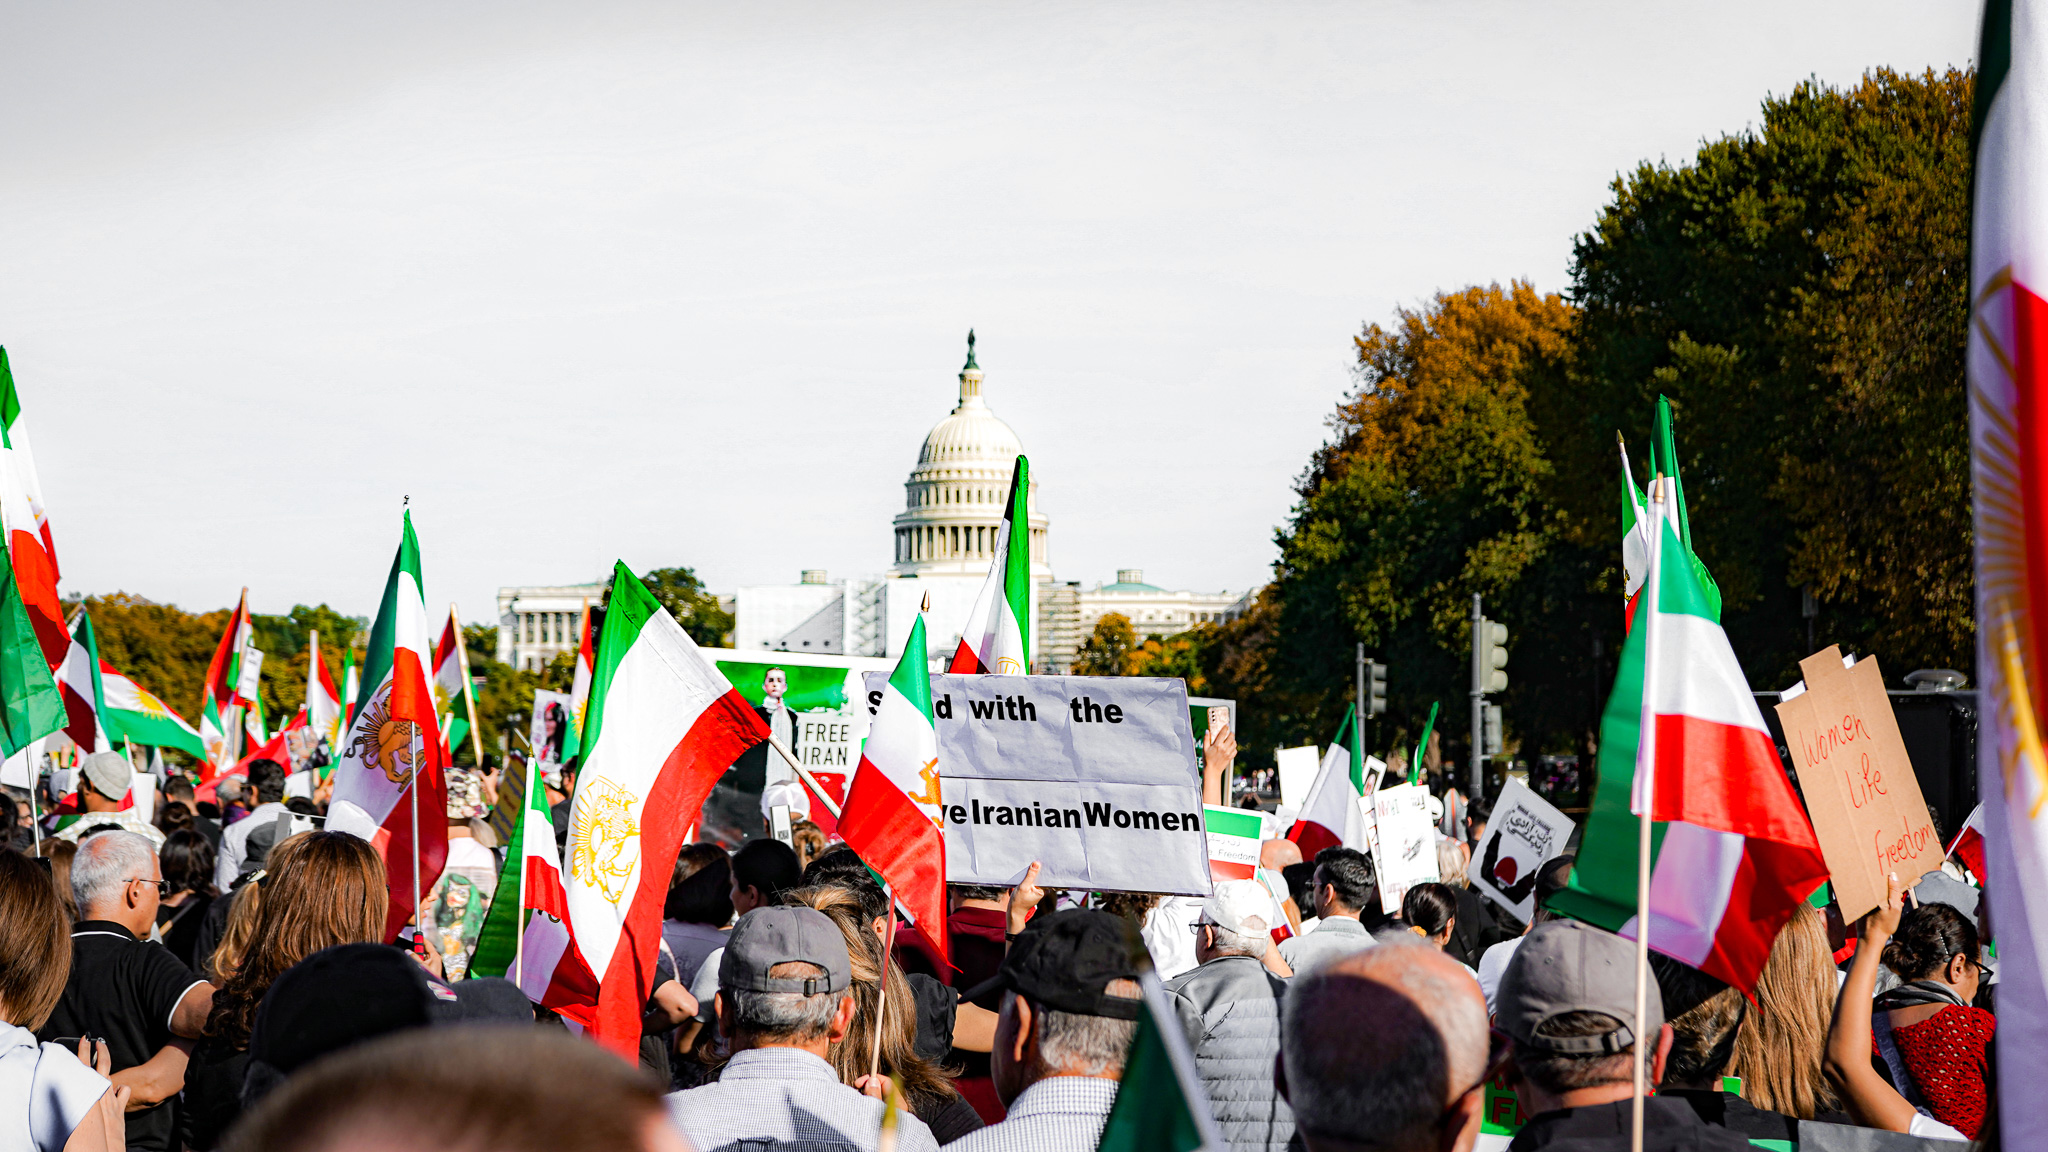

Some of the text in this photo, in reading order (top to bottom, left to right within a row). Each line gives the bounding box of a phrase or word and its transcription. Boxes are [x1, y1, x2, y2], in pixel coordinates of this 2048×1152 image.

[969, 694, 1037, 722] with
[1070, 696, 1124, 724] the
[805, 723, 850, 742] FREE
[1799, 714, 1871, 767] Women
[803, 747, 848, 766] IRAN
[1845, 752, 1887, 808] Life
[972, 799, 1082, 829] Iranian
[1082, 801, 1201, 832] Women
[1218, 848, 1256, 861] Freedom
